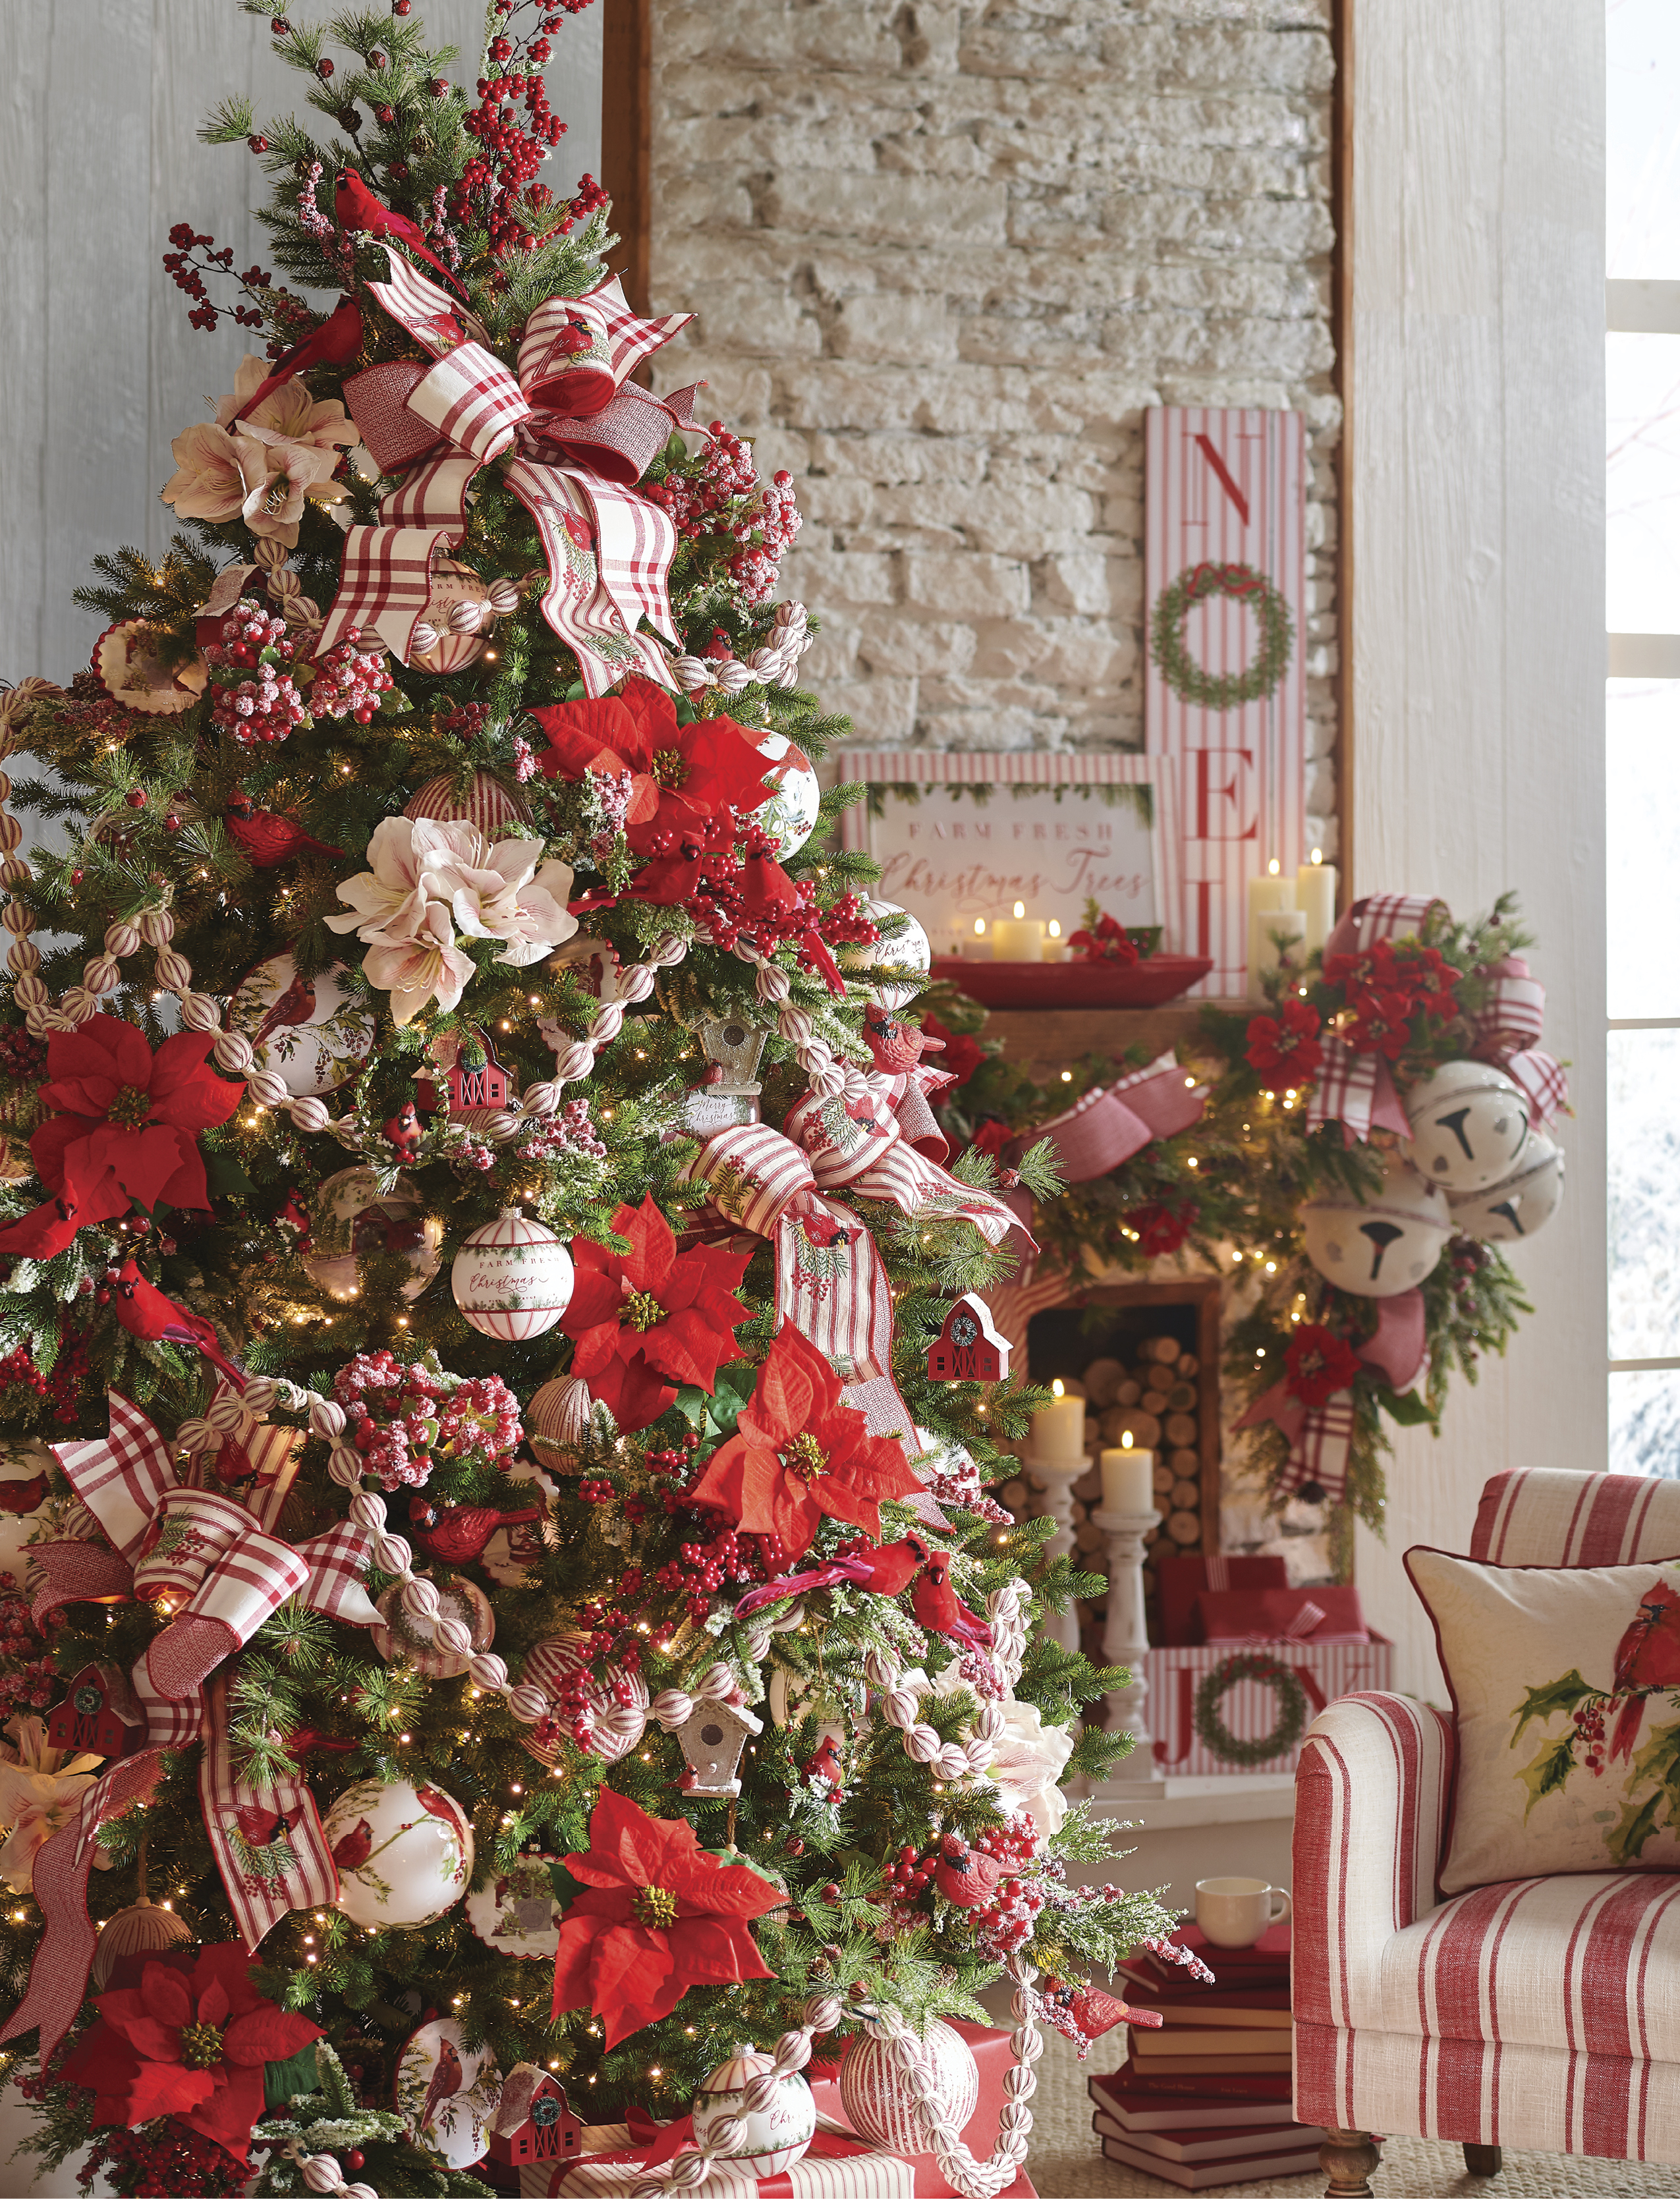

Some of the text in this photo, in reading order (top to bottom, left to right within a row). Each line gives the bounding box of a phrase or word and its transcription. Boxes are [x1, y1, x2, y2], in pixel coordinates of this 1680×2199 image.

[461, 584, 486, 594] FRES
[909, 822, 1113, 840] FARM FRESH
[879, 846, 1149, 914] Christmas Trees
[693, 1099, 733, 1113] Merry
[689, 1111, 735, 1131] Christmas
[480, 1260, 513, 1268] FARM
[470, 1273, 538, 1298] Christmas
